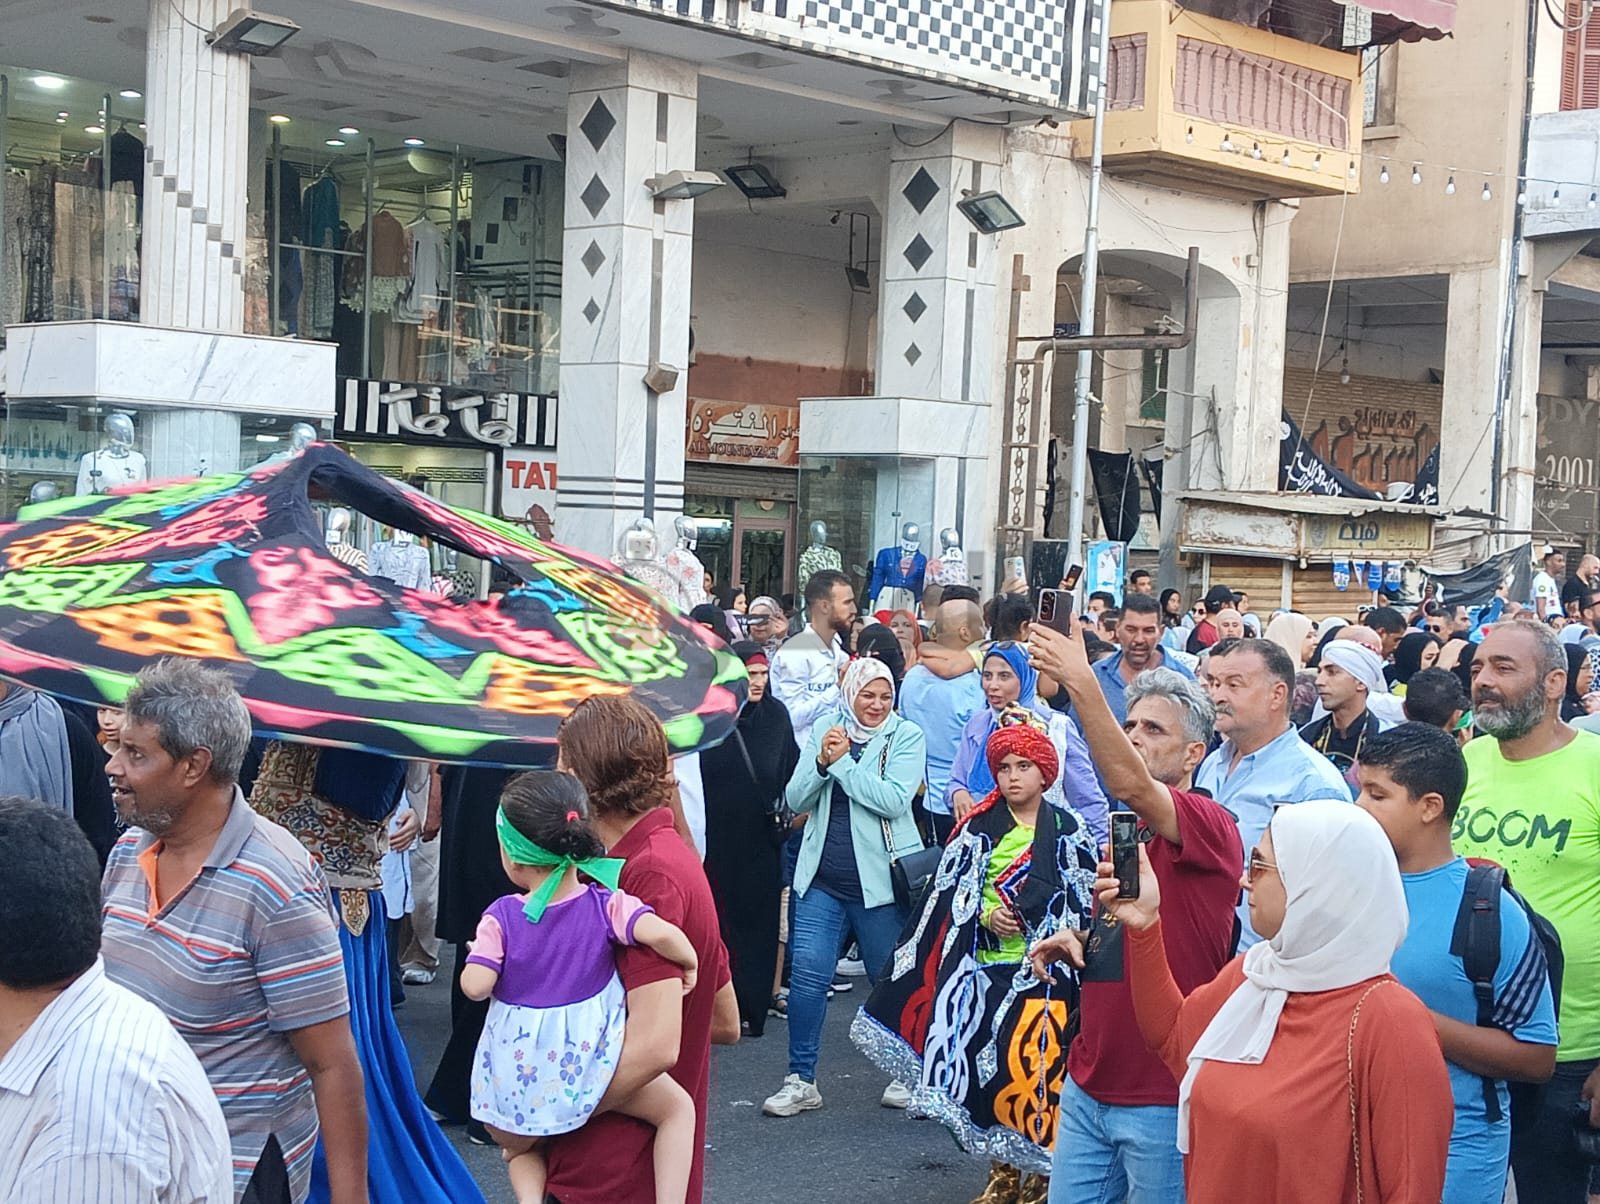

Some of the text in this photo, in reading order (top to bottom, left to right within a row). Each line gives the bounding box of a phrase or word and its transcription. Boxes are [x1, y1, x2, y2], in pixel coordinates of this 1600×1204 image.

[1550, 398, 1595, 425] DY
[687, 440, 705, 453] AL
[1545, 454, 1595, 494] 2001
